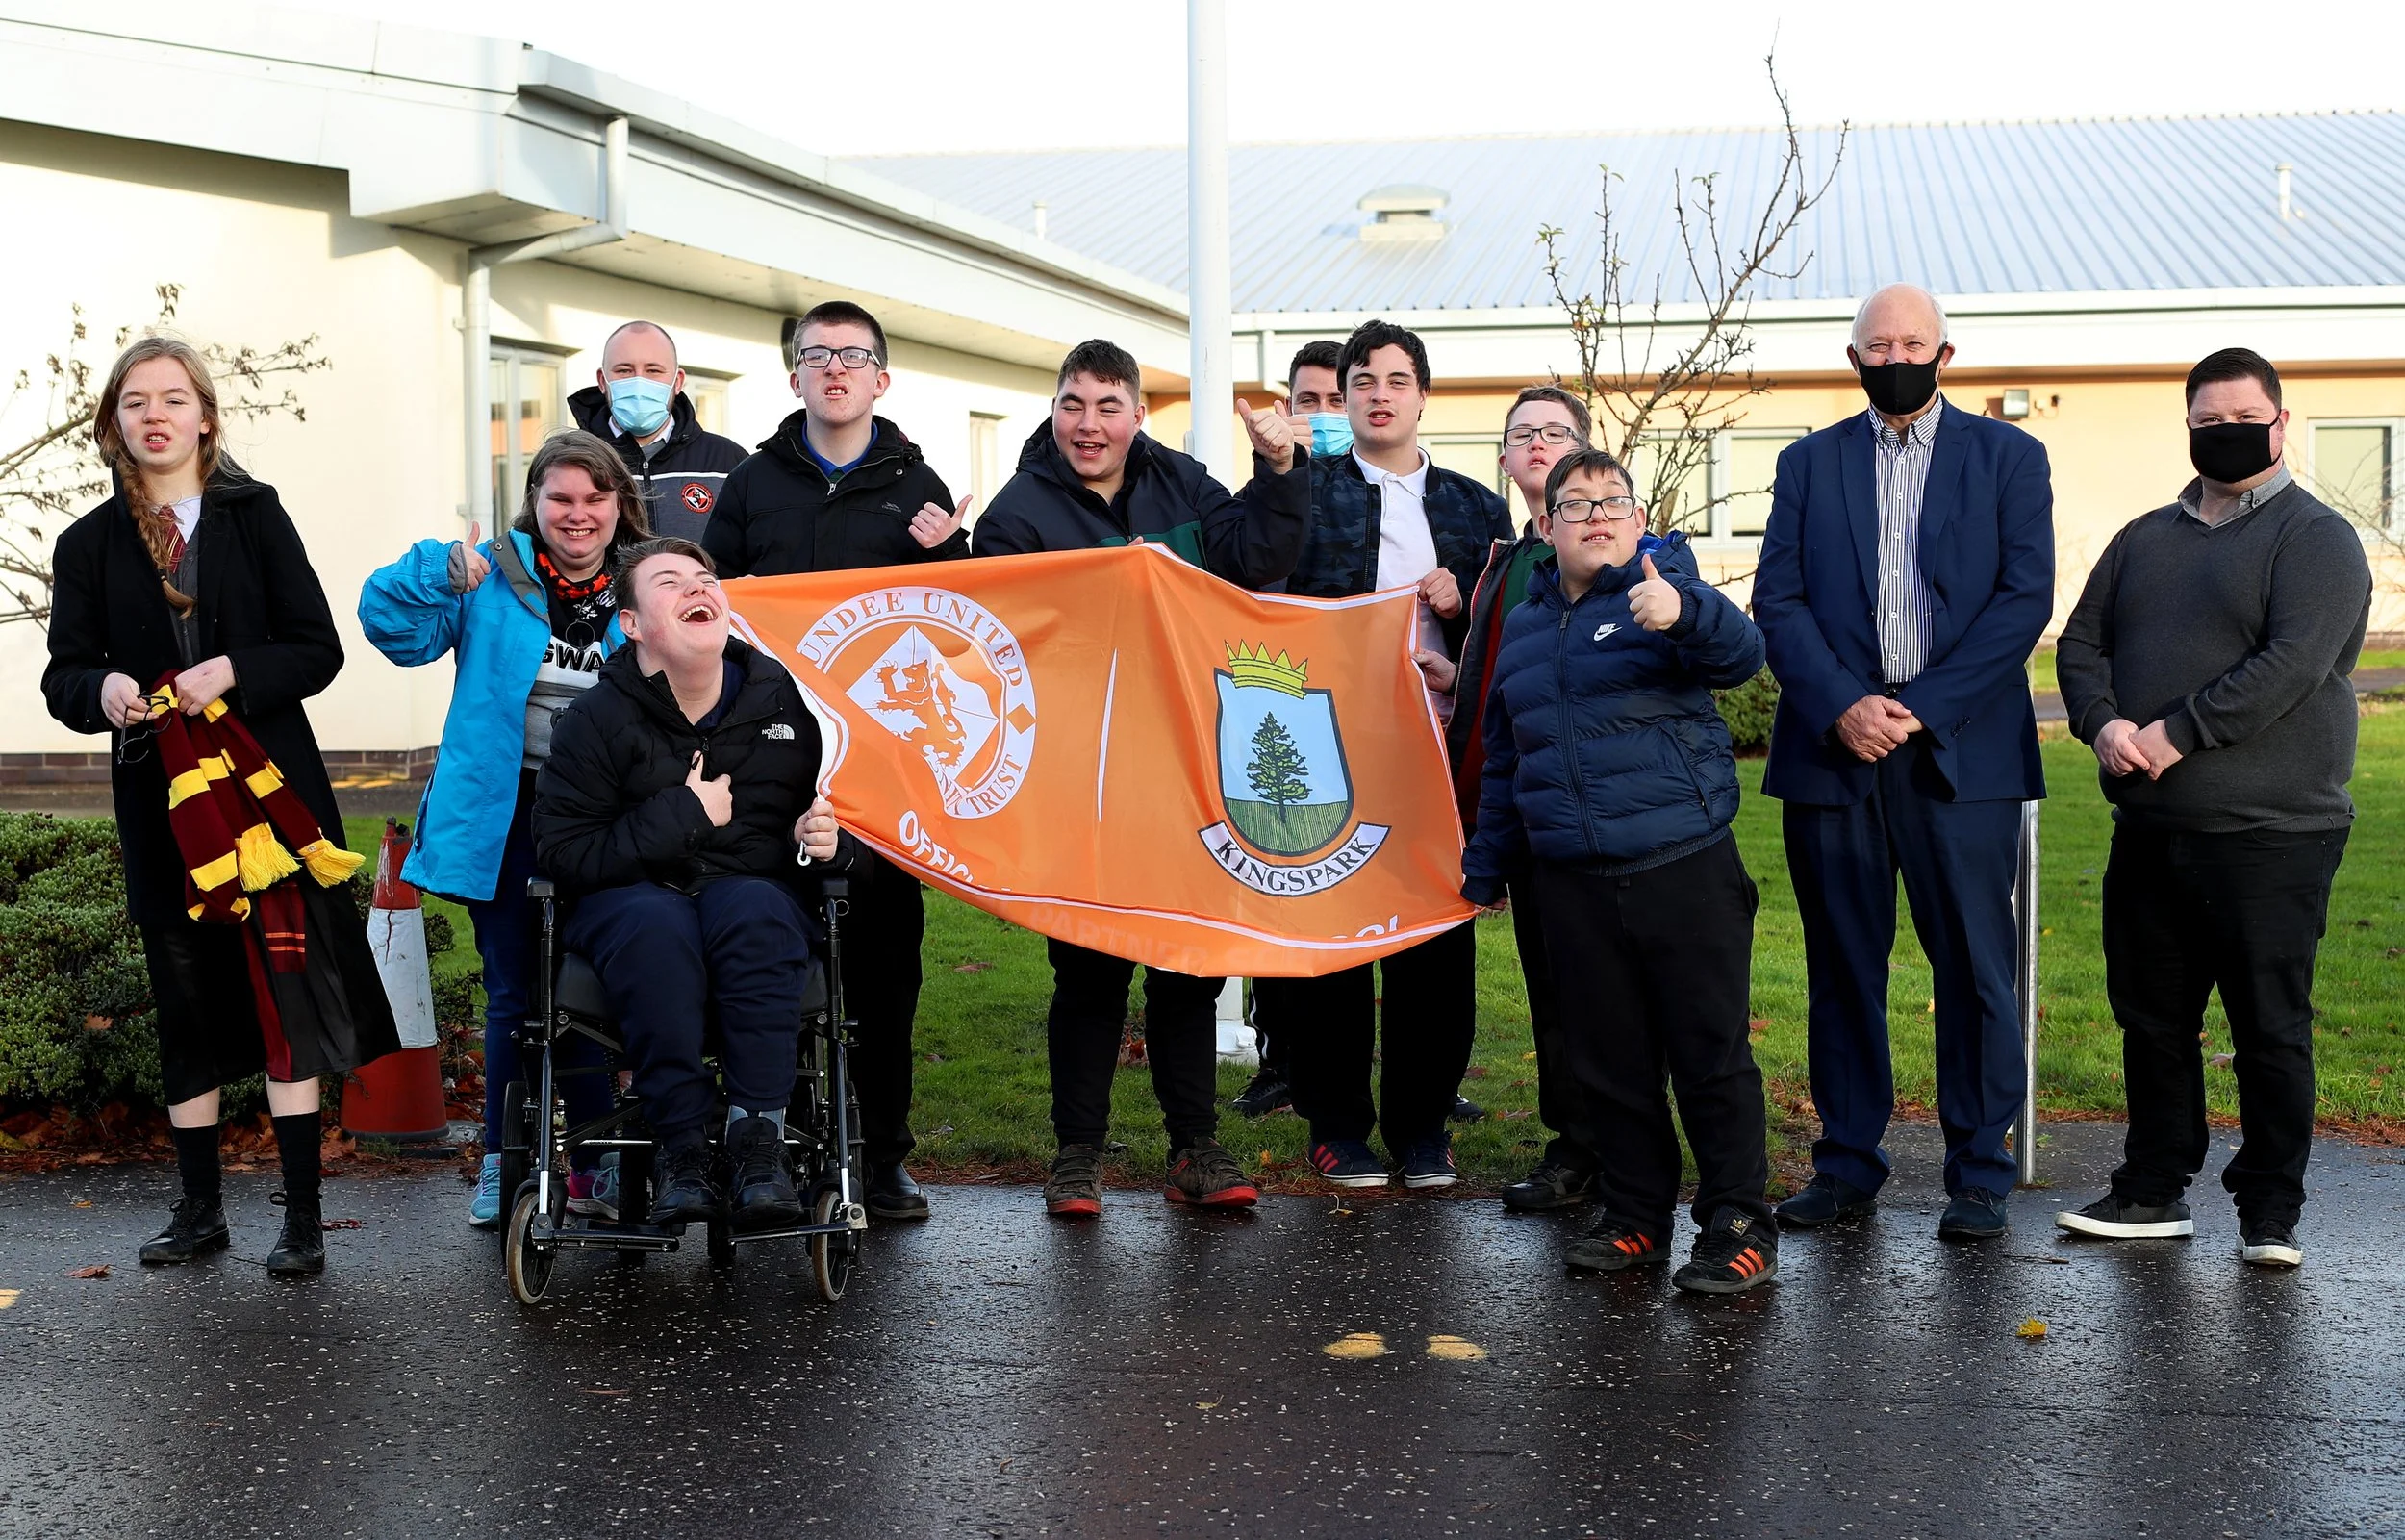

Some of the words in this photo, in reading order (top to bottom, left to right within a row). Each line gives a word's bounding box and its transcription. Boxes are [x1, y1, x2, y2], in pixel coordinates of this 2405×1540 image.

[799, 592, 905, 665] UNDEE
[924, 592, 1024, 687] UNITED
[965, 753, 1024, 815] TRUST
[1214, 836, 1377, 893] KINGSPARK
